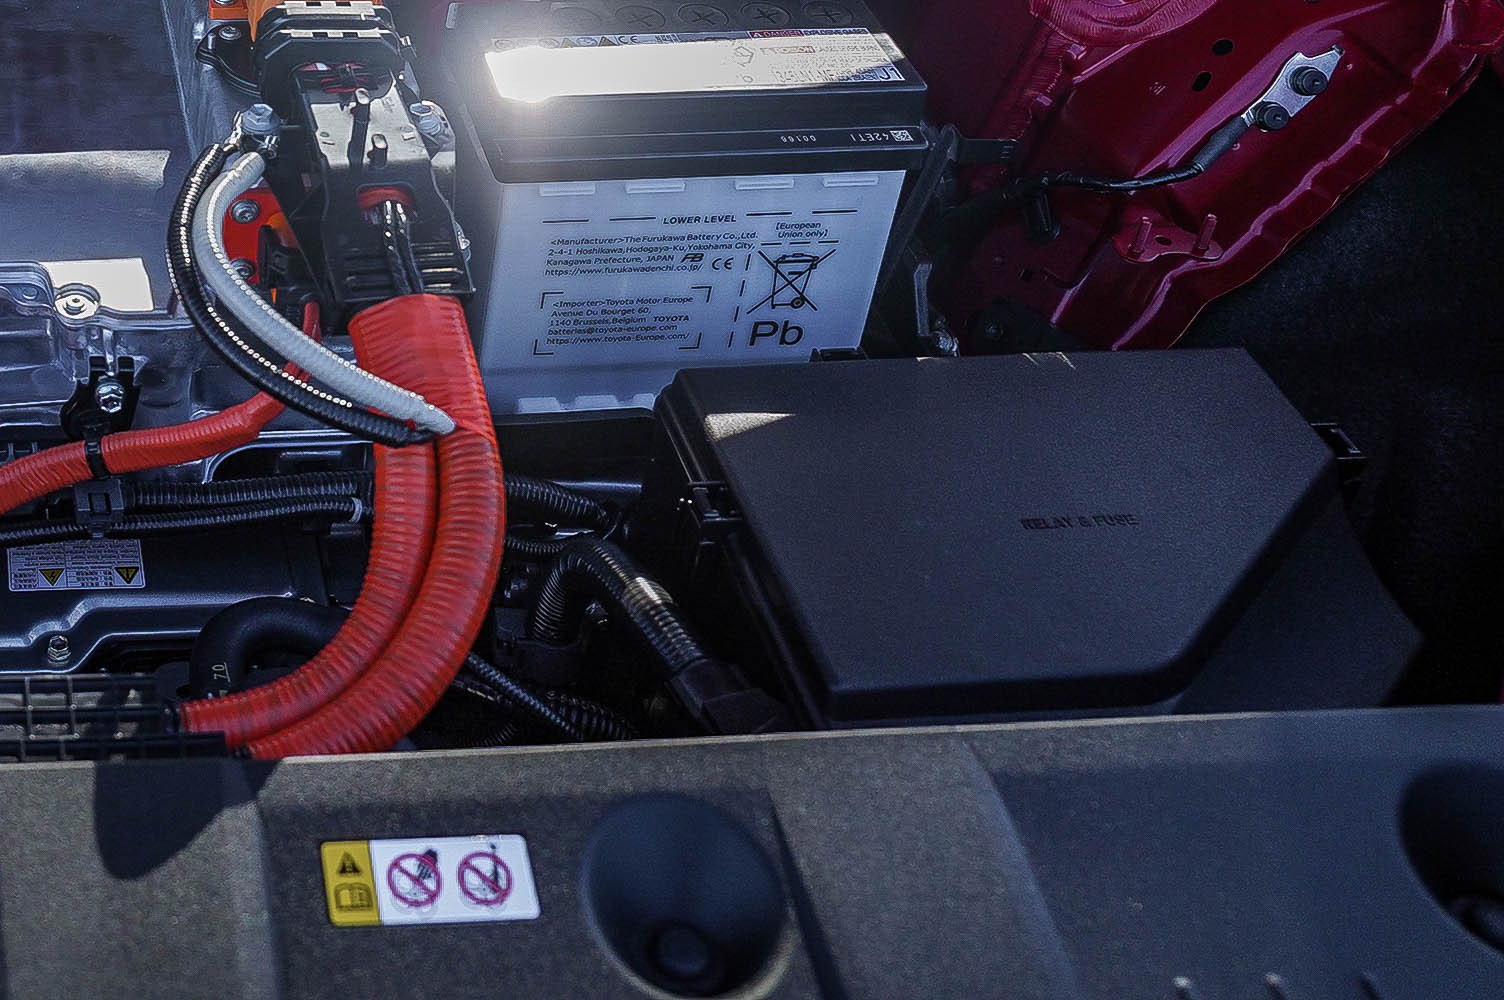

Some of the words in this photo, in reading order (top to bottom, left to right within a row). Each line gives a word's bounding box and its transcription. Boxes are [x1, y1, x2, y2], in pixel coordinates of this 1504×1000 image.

[765, 30, 802, 38] DANGER
[878, 66, 904, 81] J1
[663, 216, 701, 225] LOWER
[704, 215, 736, 223] LEVEL
[642, 234, 686, 244] Furukawa
[687, 233, 723, 243] Battery
[548, 249, 573, 257] 2-4-1
[735, 241, 755, 250] City,
[546, 258, 592, 268] Kanagawa
[594, 256, 643, 266] Prefecture,
[646, 254, 674, 262] JAPAN
[636, 296, 662, 304] Motor
[663, 295, 694, 304] Europe
[551, 309, 585, 317] Avenue
[586, 308, 599, 316] Du
[600, 307, 635, 317] Bourget
[549, 319, 572, 327] 1140
[653, 314, 690, 323] TOYOTA
[548, 324, 678, 336] batteries@toyota-europe.com
[748, 320, 804, 346] Pb
[1020, 516, 1073, 530] RELAY
[1093, 513, 1139, 527] FUSE
